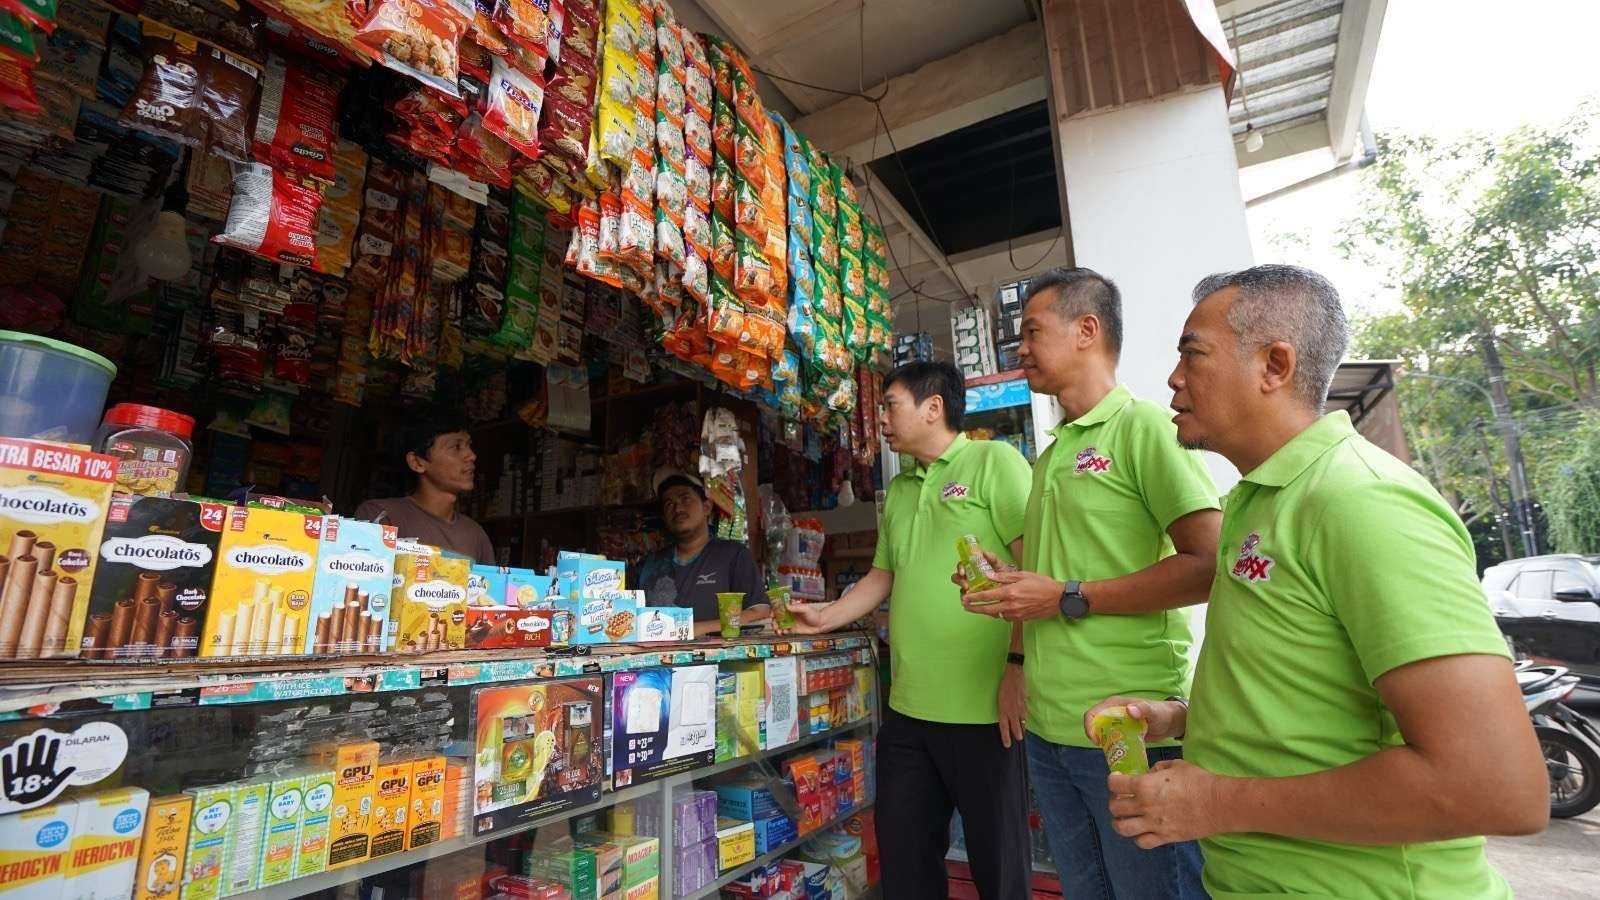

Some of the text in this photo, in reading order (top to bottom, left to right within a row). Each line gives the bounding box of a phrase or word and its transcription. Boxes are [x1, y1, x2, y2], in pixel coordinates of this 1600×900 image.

[0, 444, 29, 466] TRA
[32, 449, 81, 474] BESAR
[84, 458, 113, 479] 10%
[203, 508, 223, 521] 24
[305, 519, 321, 531] 24
[383, 530, 396, 540] 24
[524, 633, 541, 641] RICH
[588, 684, 600, 693] NEW
[65, 735, 110, 746] DILARAN
[343, 765, 371, 779] GPU
[10, 774, 53, 796] 18+
[381, 777, 406, 790] GPU
[417, 774, 441, 787] GPU
[72, 840, 136, 868] HEROCYN
